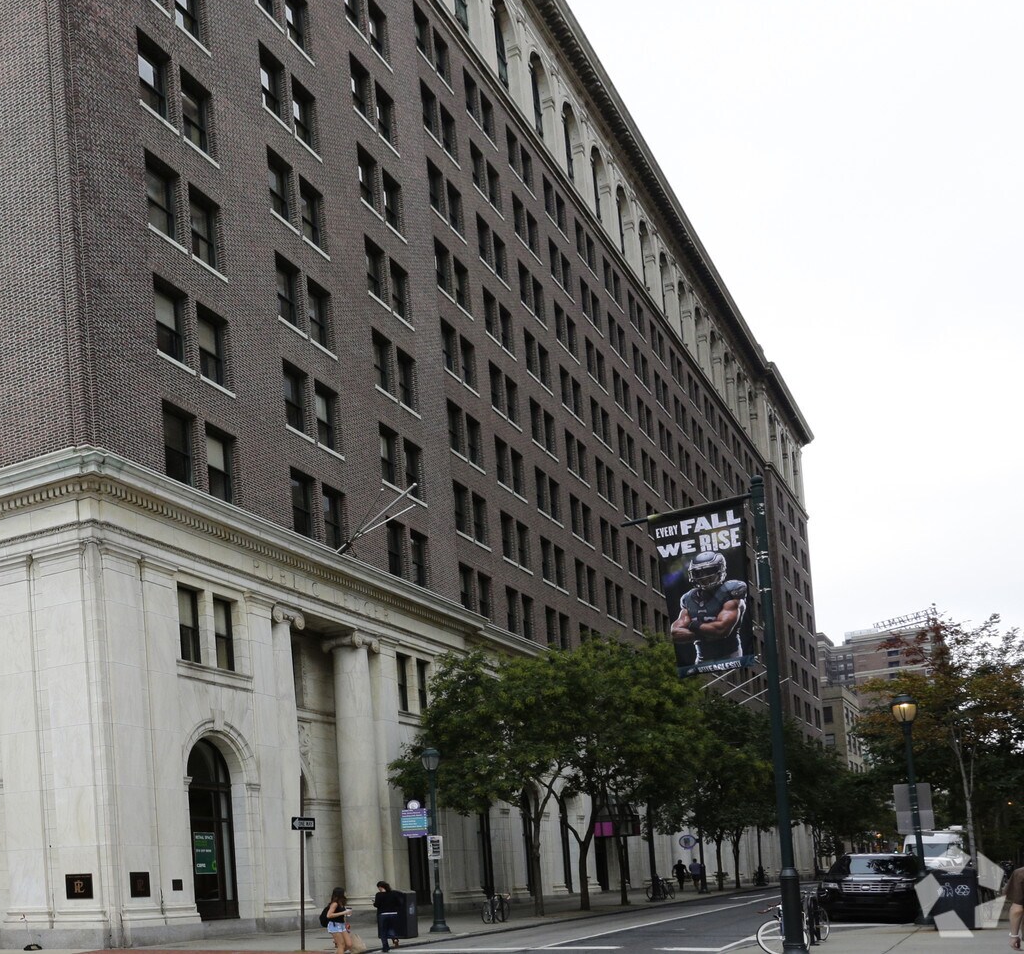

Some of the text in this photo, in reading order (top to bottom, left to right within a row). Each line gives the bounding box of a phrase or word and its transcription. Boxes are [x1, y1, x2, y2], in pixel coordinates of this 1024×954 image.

[655, 509, 741, 539] EVERY FALL
[657, 527, 741, 558] WE RISE
[253, 559, 321, 598] PUBLIC
